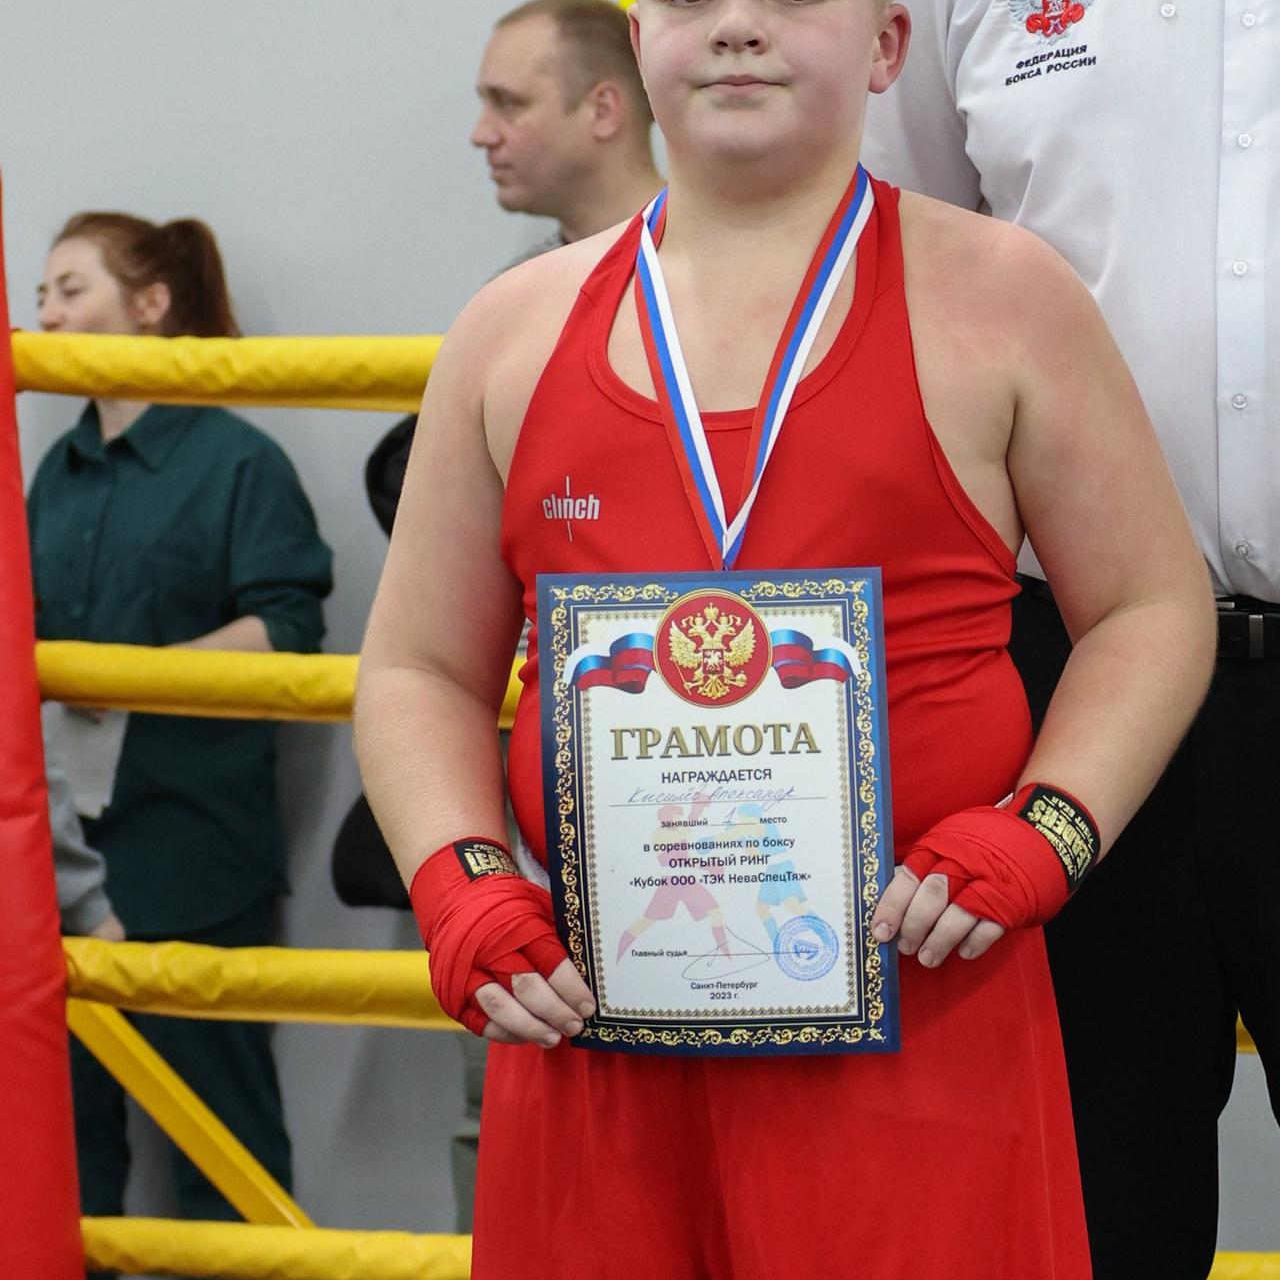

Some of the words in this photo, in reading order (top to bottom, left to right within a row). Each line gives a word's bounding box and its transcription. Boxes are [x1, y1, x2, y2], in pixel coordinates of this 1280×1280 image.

[1015, 44, 1088, 69] ФЕДЕРАЦИЯ
[1005, 67, 1042, 86] БОКСА
[1046, 56, 1097, 74] РОССИИ
[542, 493, 600, 520] clinch
[610, 722, 822, 760] ГРАМОТА
[661, 768, 772, 784] НАГРАЖДАЕТСЯ
[660, 818, 709, 828] занявший
[722, 807, 737, 824] 1
[759, 816, 787, 824] место
[643, 844, 650, 852] в
[653, 840, 743, 853] соревнованиях
[745, 839, 760, 848] по
[763, 837, 795, 849] боксу
[1027, 799, 1091, 878] LEADERS
[668, 854, 737, 868] ОТКРЫТЫЙ
[740, 855, 771, 866] РИНГ
[670, 875, 696, 886] ООО
[631, 948, 665, 957] Главный
[666, 950, 688, 958] судья
[690, 981, 758, 990] Санкт-Петербург
[710, 992, 732, 1000] 2023
